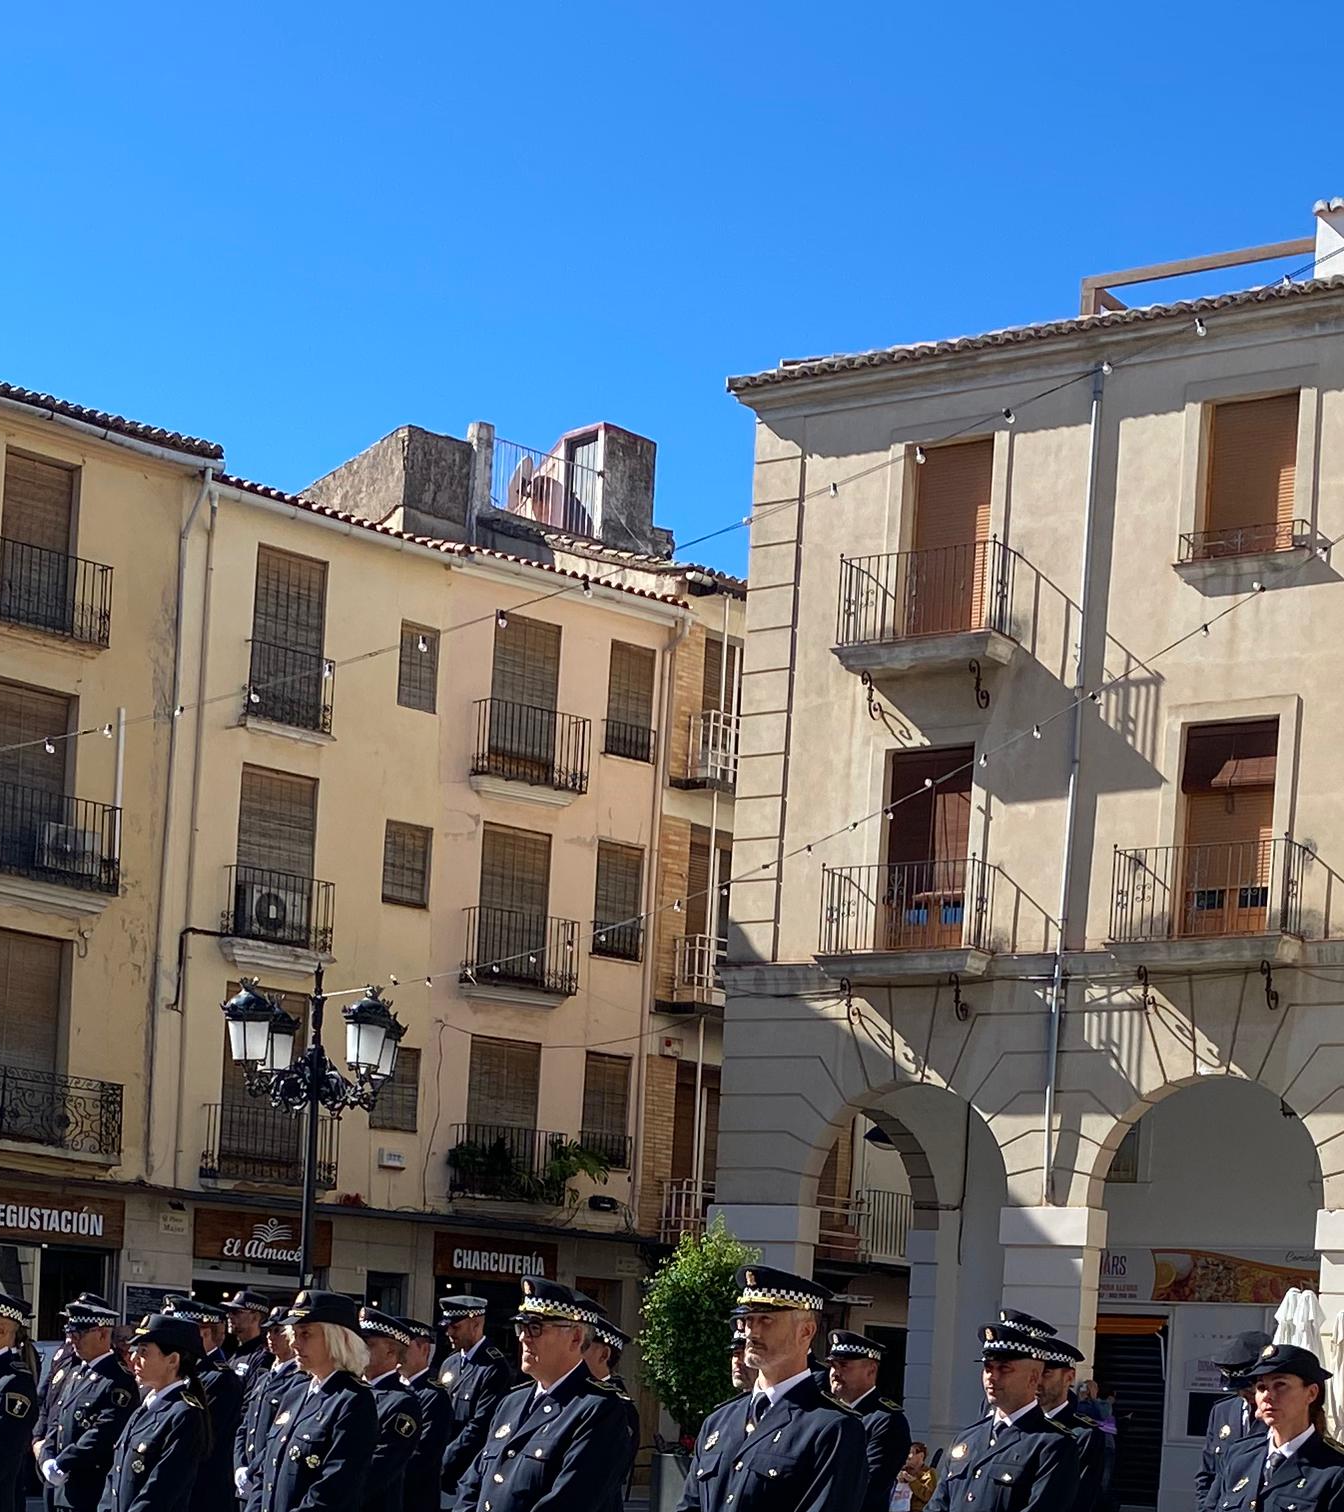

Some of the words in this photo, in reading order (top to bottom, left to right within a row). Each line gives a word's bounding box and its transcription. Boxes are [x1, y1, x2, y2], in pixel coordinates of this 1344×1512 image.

[223, 1238, 241, 1257] El
[453, 1248, 545, 1277] CHARCUTERÍA
[1100, 1250, 1126, 1275] ARS
